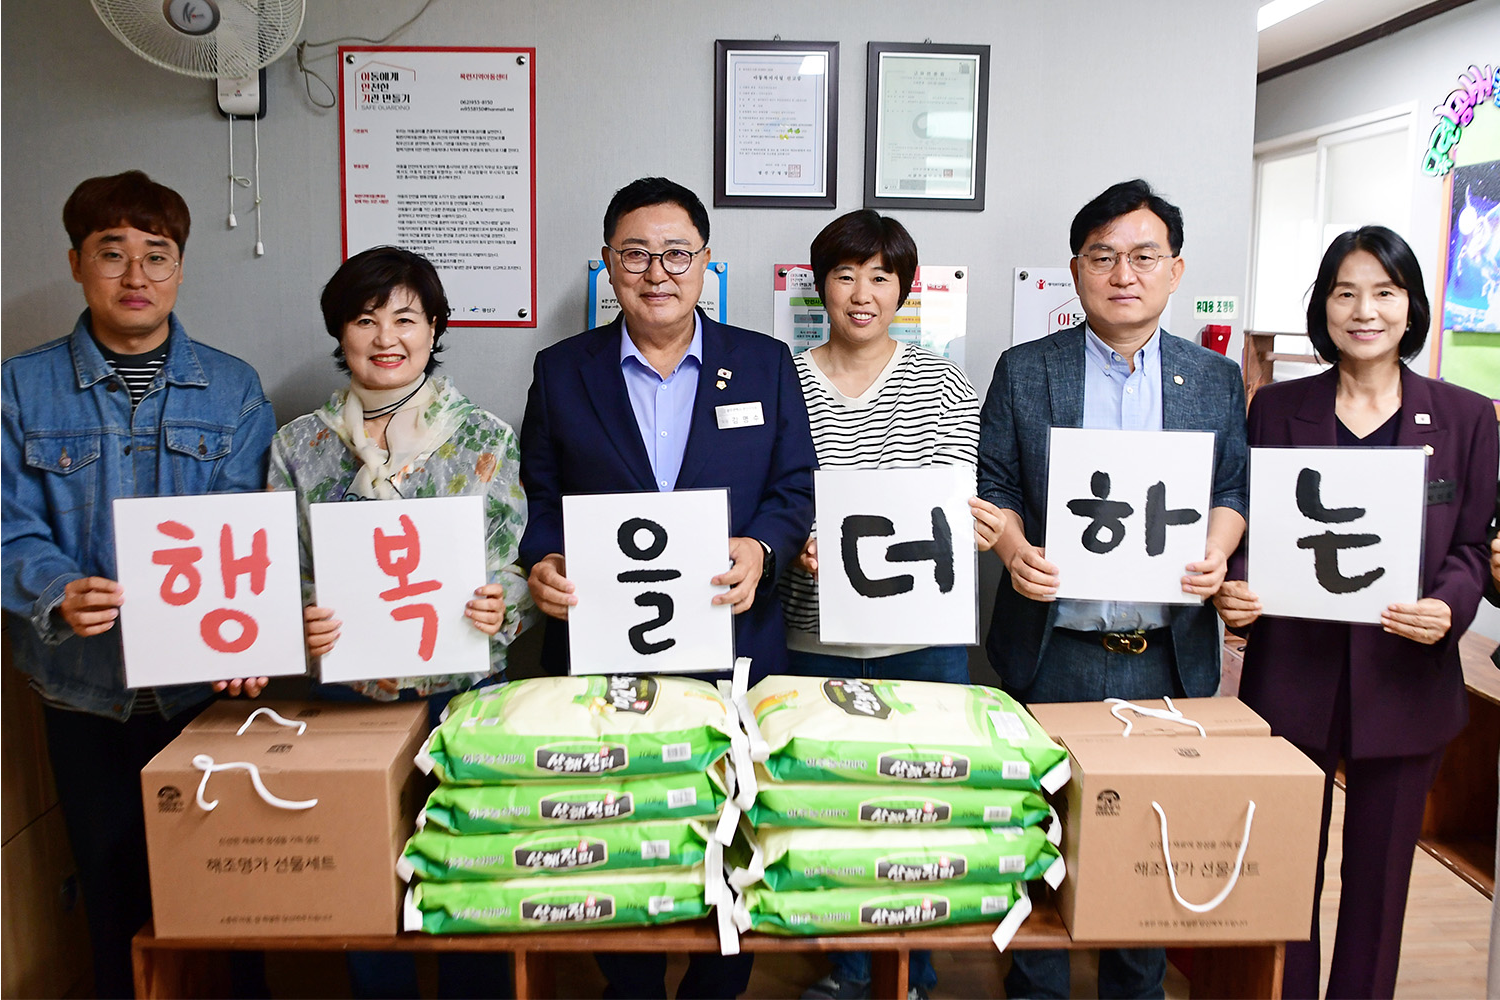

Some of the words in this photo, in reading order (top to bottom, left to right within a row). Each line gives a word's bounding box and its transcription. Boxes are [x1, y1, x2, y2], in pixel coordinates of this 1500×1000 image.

[361, 72, 399, 81] 아동에게
[841, 506, 954, 598] 더
[1067, 470, 1201, 556] 하
[1296, 467, 1386, 595] 는
[152, 520, 271, 653] 행
[373, 514, 441, 661] 복
[617, 517, 681, 655] 을
